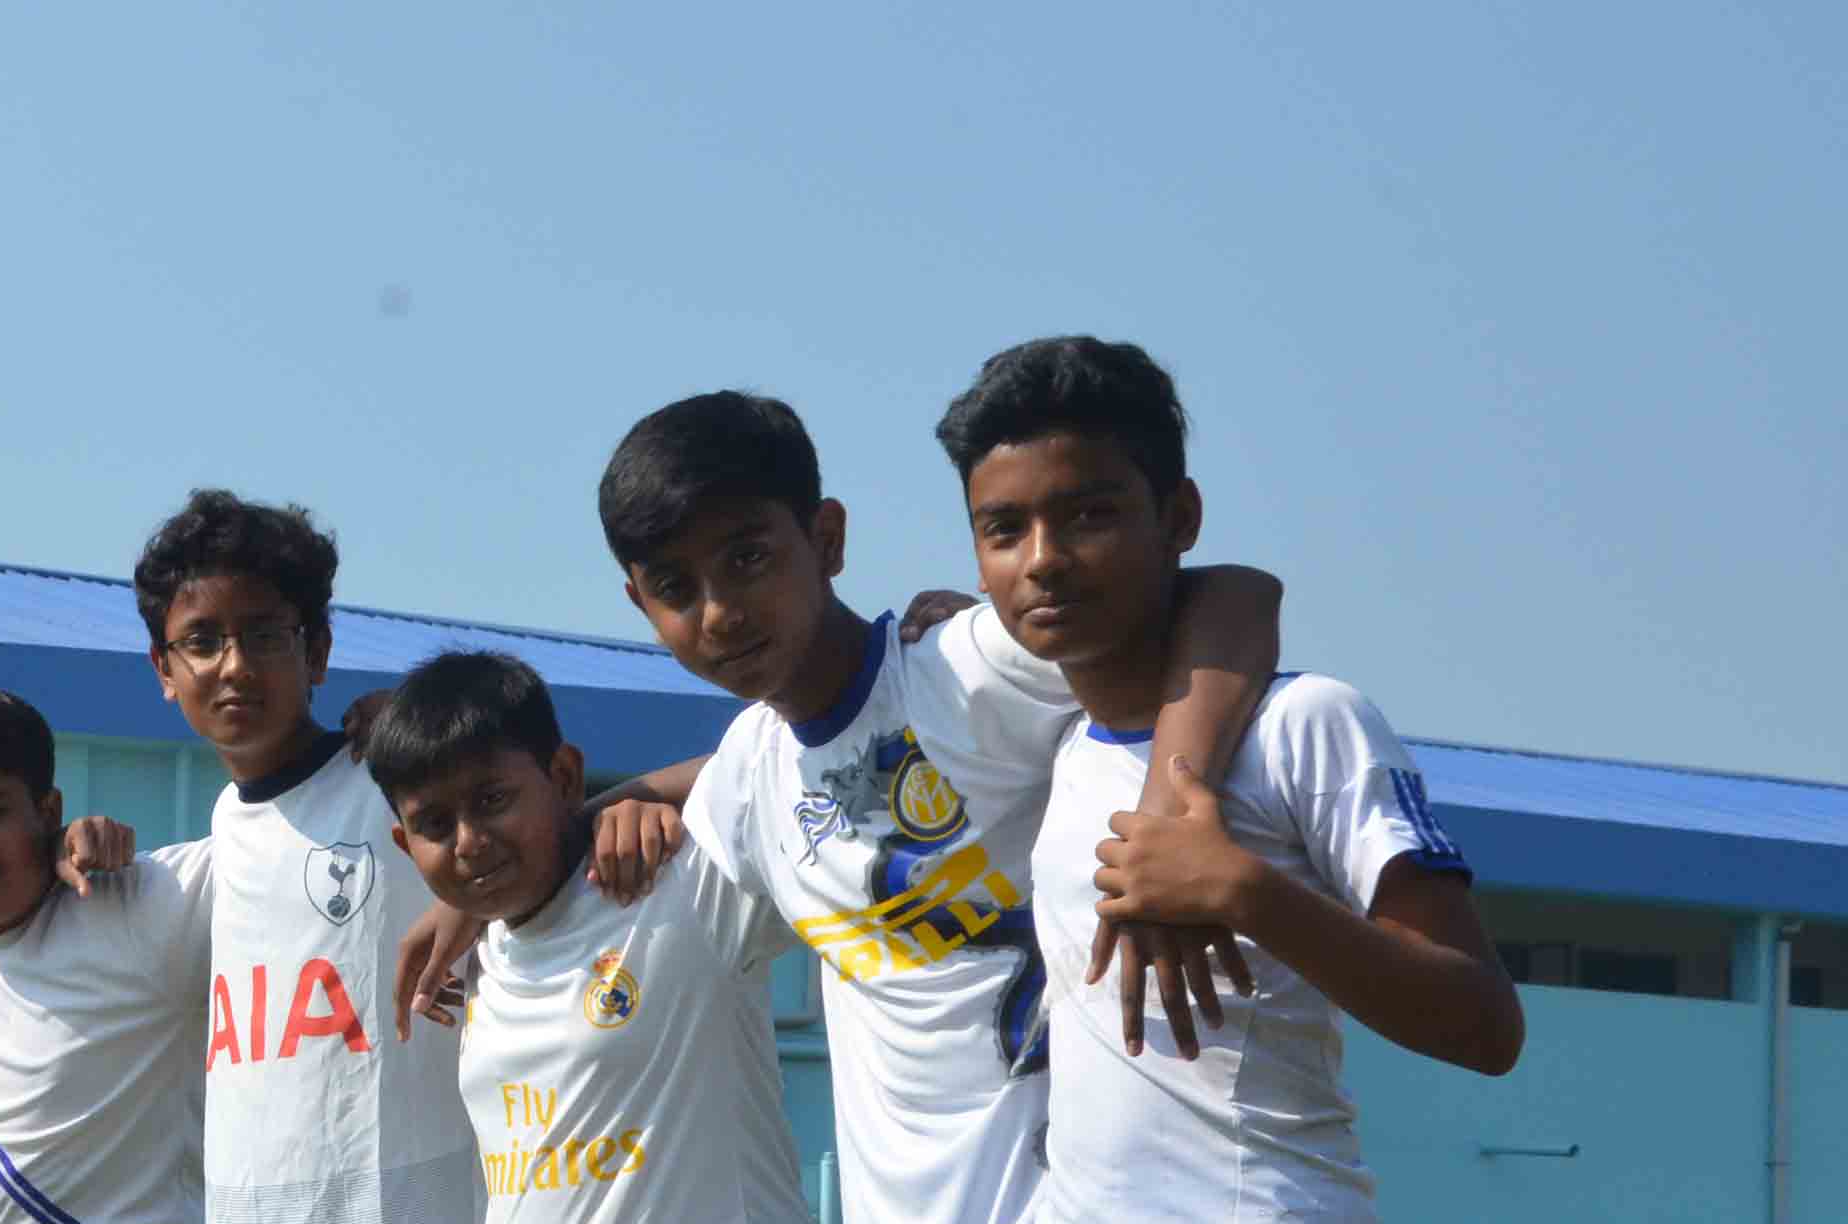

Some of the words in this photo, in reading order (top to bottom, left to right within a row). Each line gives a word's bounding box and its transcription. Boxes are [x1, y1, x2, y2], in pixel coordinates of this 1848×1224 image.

[206, 958, 373, 1072] AIA
[502, 1081, 557, 1134] Fly
[483, 1127, 648, 1197] mirates
